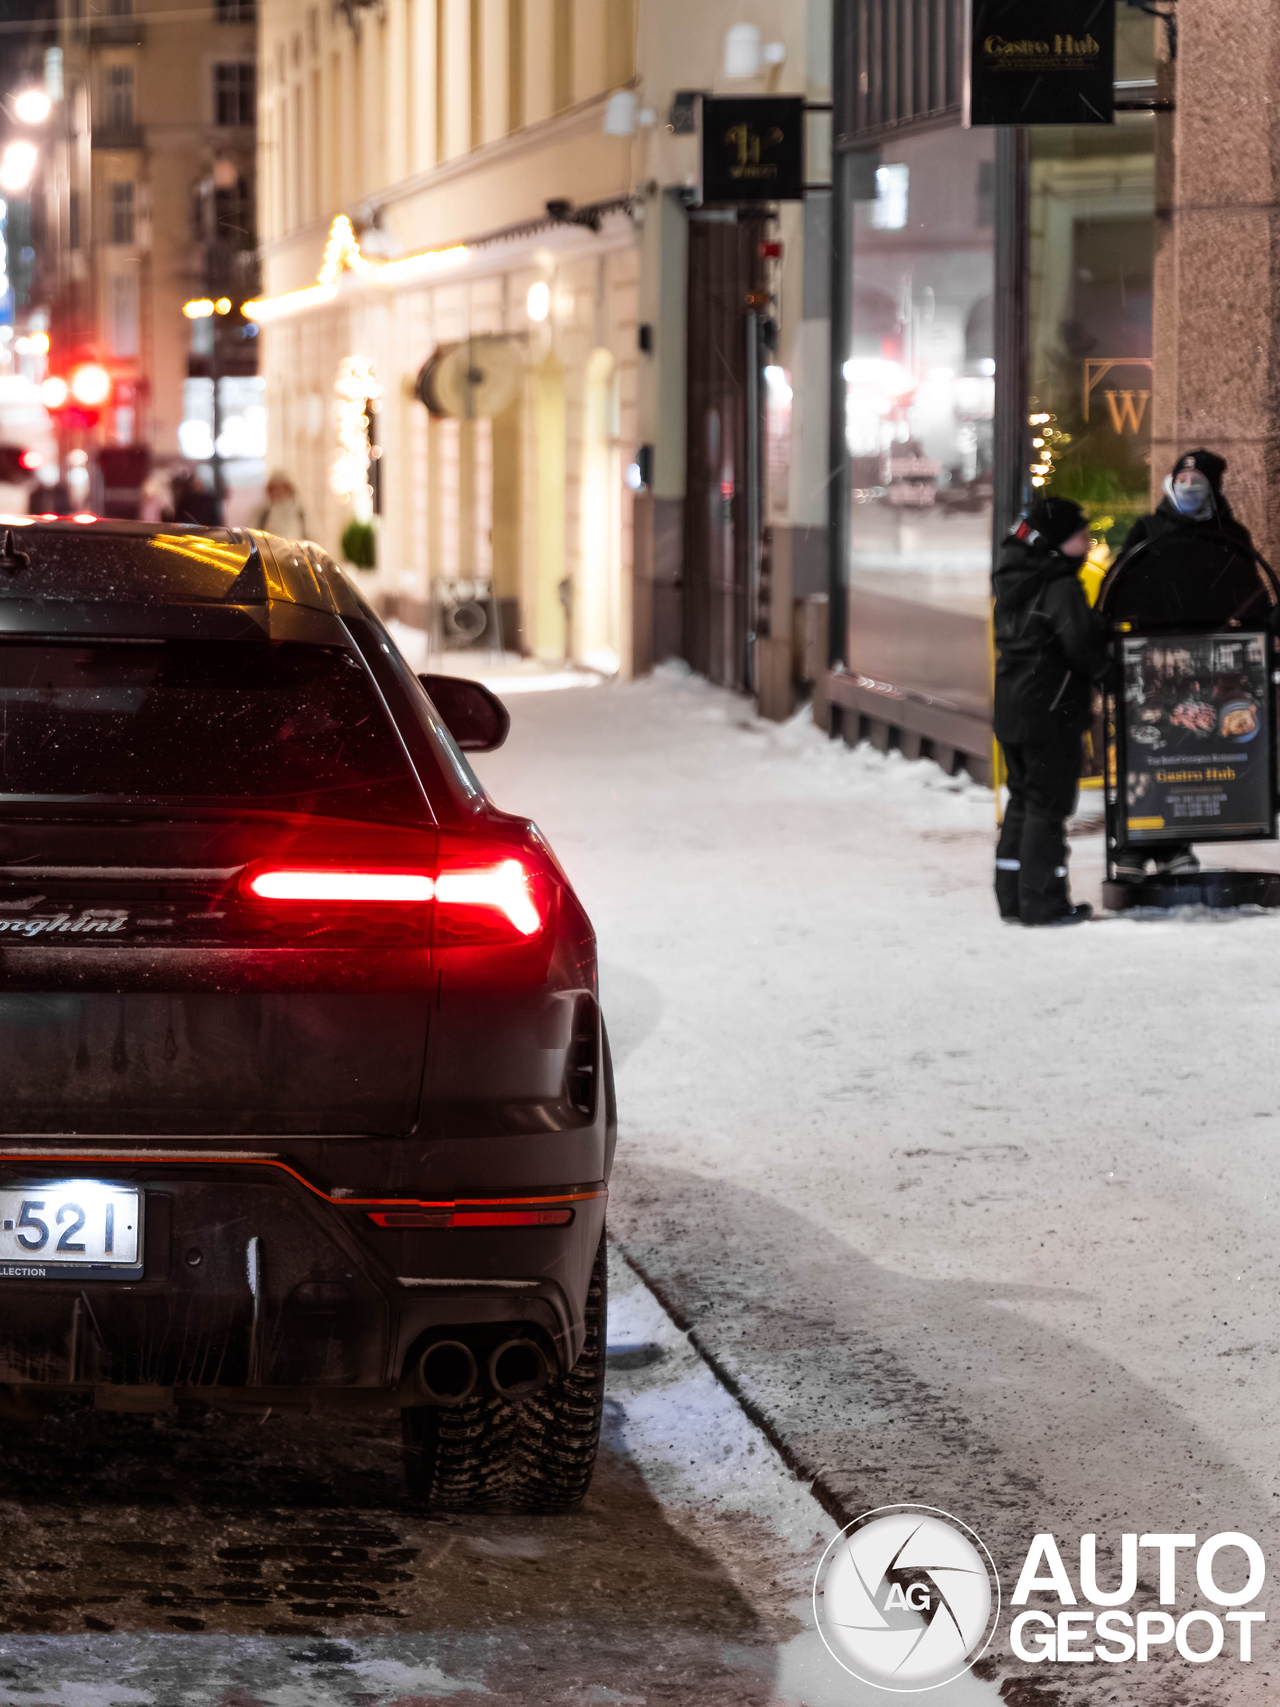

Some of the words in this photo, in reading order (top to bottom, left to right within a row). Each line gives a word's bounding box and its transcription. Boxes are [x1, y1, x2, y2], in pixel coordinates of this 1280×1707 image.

[1054, 33, 1100, 55] Hub
[1156, 769, 1202, 783] Gastro
[1205, 766, 1236, 781] Hub
